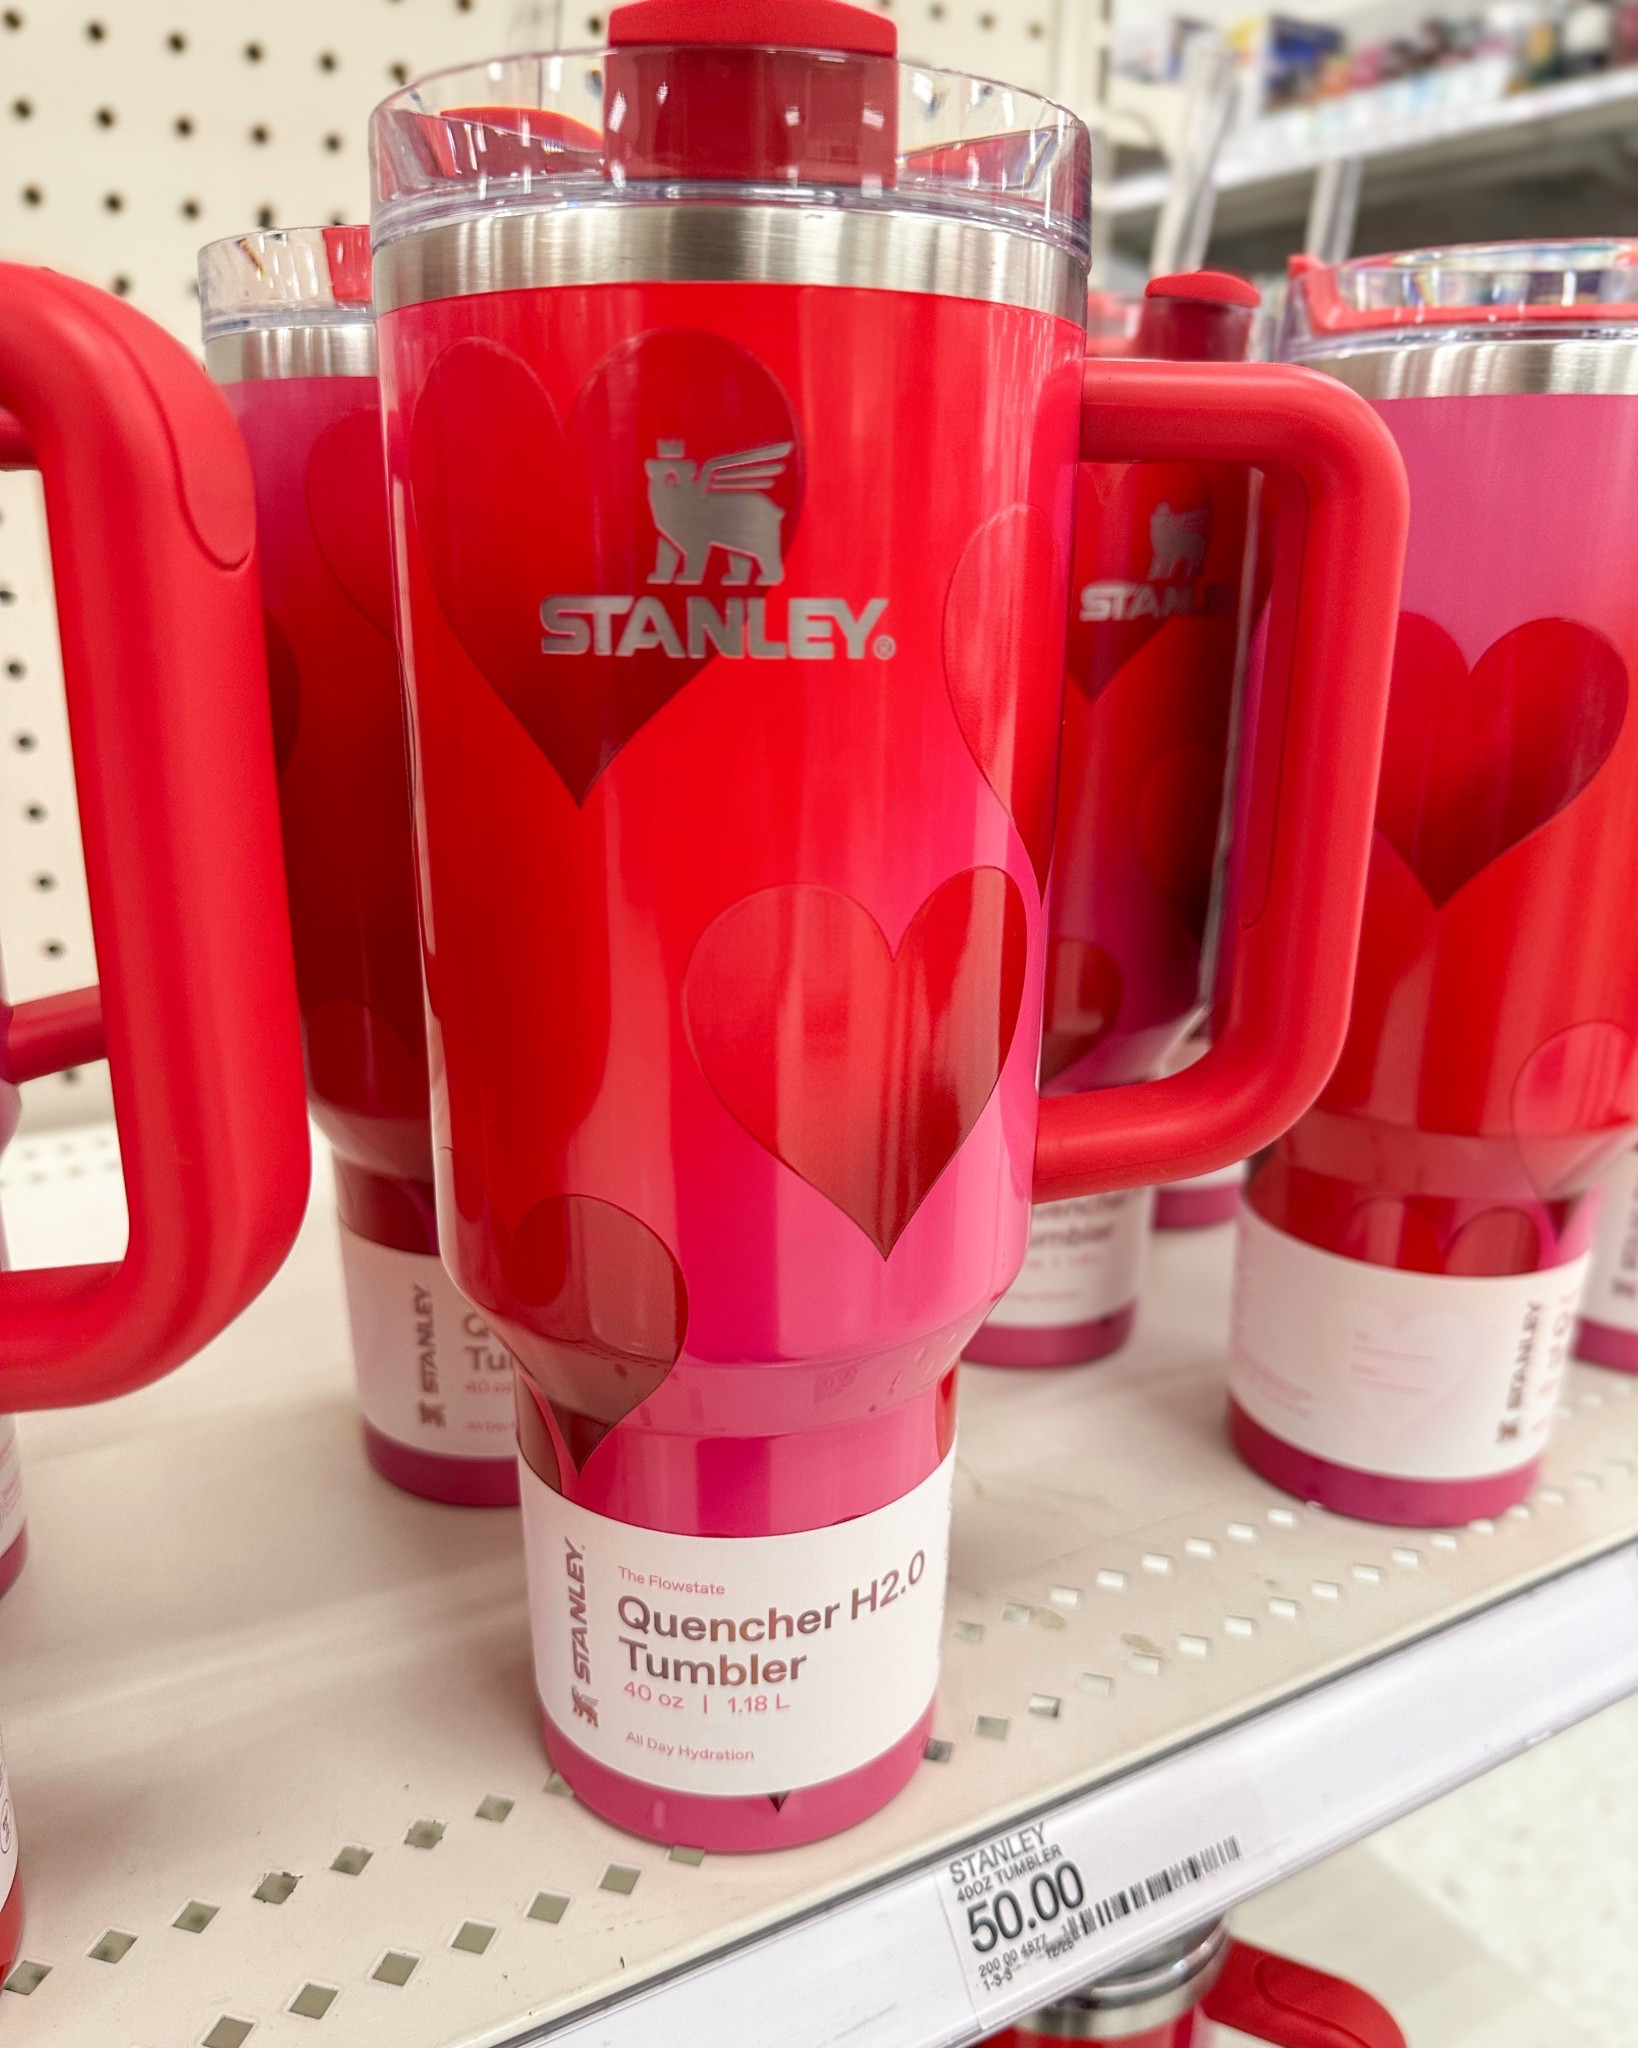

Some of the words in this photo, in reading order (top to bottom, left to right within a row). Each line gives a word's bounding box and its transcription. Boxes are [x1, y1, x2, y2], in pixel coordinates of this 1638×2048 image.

[414, 1284, 438, 1395] STANLEY
[617, 1595, 841, 1642] Quencher
[851, 1549, 926, 1621] H2.0
[618, 1565, 646, 1584] The
[649, 1575, 725, 1595] Flowstate
[618, 1635, 808, 1687] Tumbler
[623, 1681, 653, 1702] 40
[659, 1693, 684, 1710] oz
[728, 1693, 768, 1714] 1.18
[777, 1692, 790, 1710] L
[626, 1730, 644, 1747] All
[648, 1737, 675, 1756] Day
[679, 1744, 755, 1762] Hydration
[949, 1821, 1045, 1884] STANLEY
[995, 1843, 1063, 1885] TUMBLER
[967, 1860, 1084, 1953] 50.00
[979, 1954, 1001, 1978] 200
